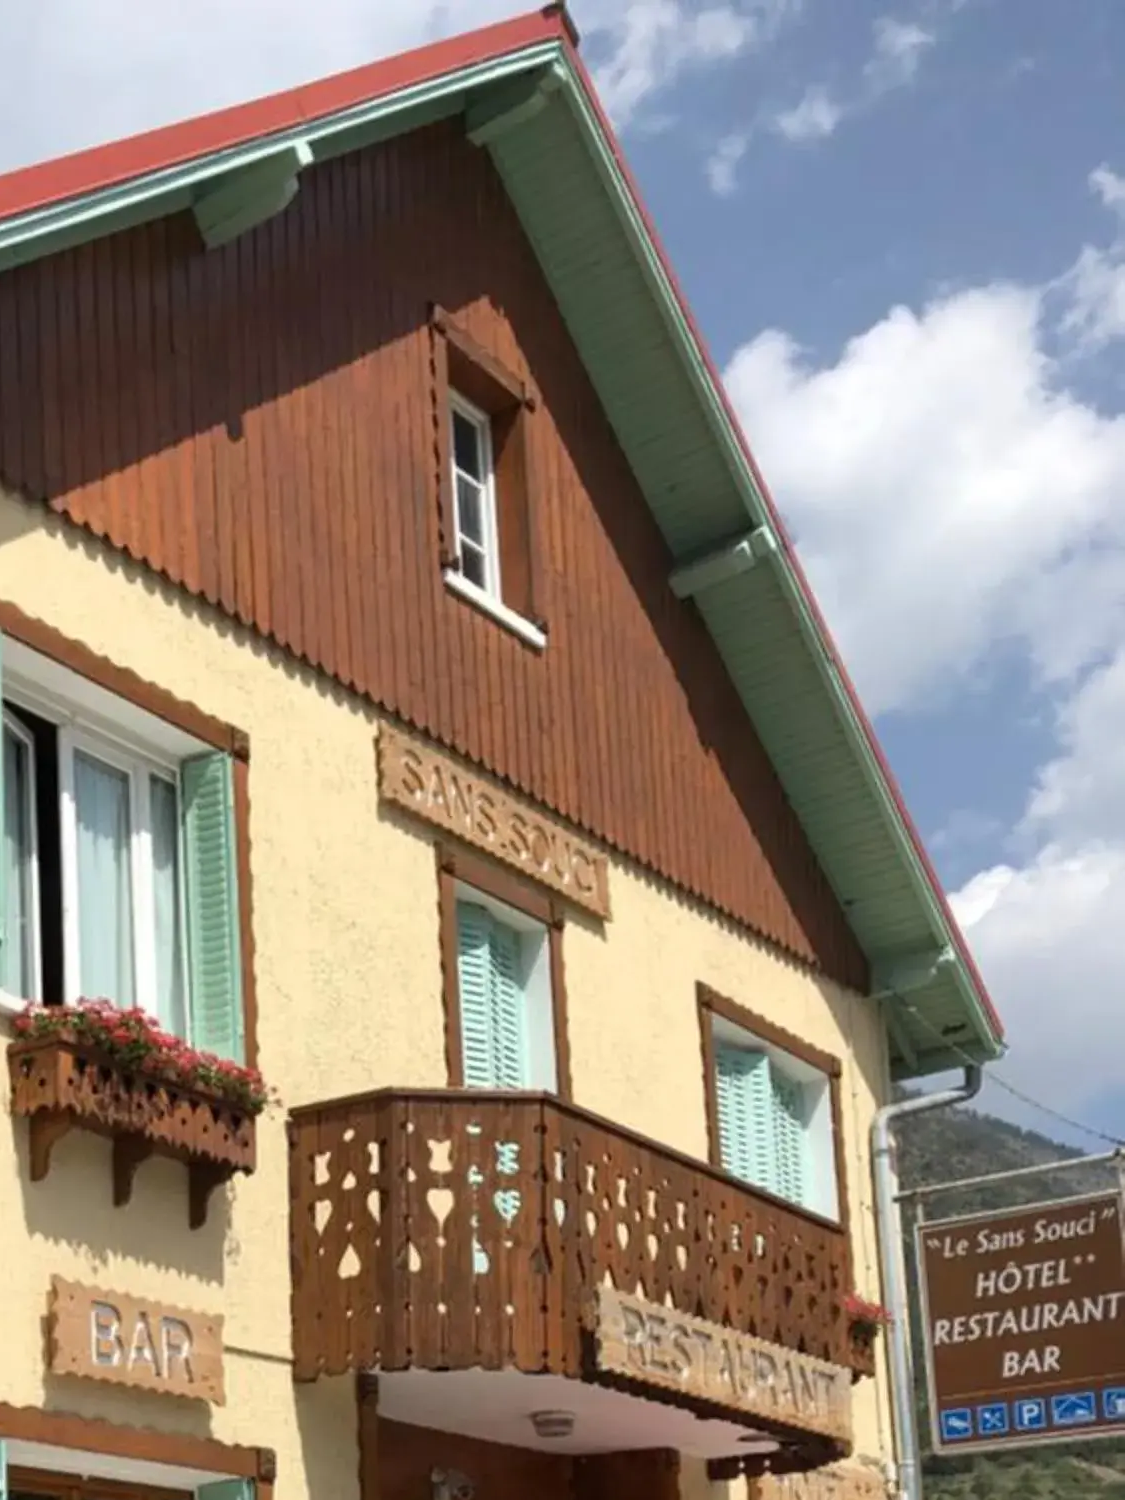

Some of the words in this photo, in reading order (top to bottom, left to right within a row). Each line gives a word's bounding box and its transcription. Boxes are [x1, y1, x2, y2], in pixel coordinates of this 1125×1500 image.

[401, 749, 498, 843] SANS
[977, 1228, 1025, 1254] Sans
[90, 1299, 194, 1384] BAR
[933, 1292, 1125, 1346] RESTAURANT
[618, 1301, 837, 1416] RESTAURANT
[1002, 1346, 1062, 1379] BAR
